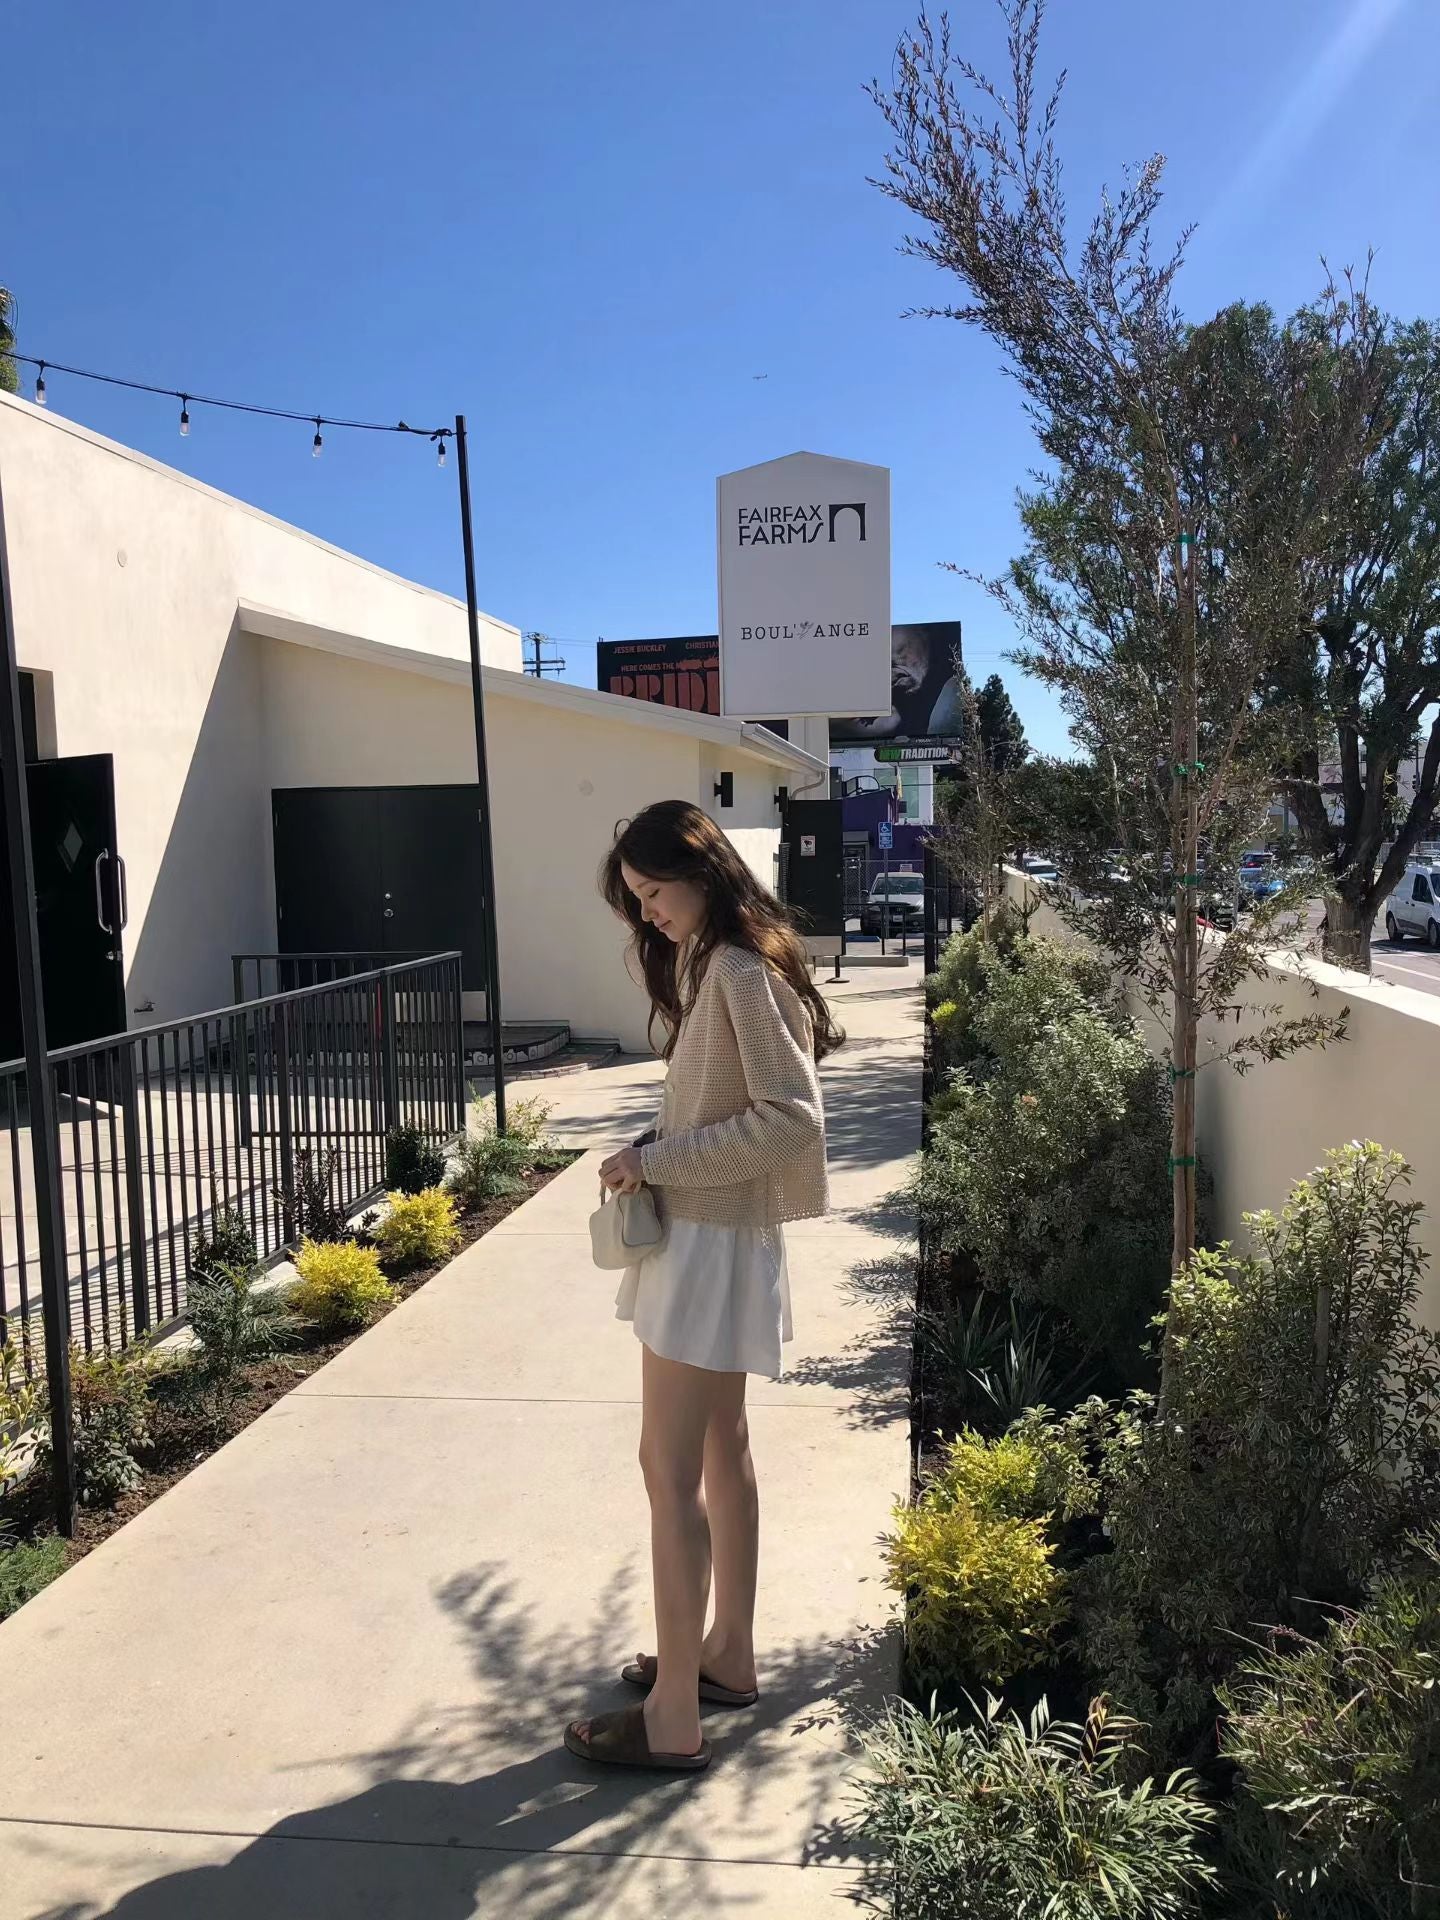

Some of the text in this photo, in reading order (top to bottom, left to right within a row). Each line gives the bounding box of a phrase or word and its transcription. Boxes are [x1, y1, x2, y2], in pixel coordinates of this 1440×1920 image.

[738, 505, 822, 524] FAIRFAX
[738, 522, 824, 546] FARMS
[636, 644, 666, 653] BUCKLEY
[621, 664, 638, 672] HERE
[639, 663, 661, 671] COMES
[662, 662, 674, 671] THE
